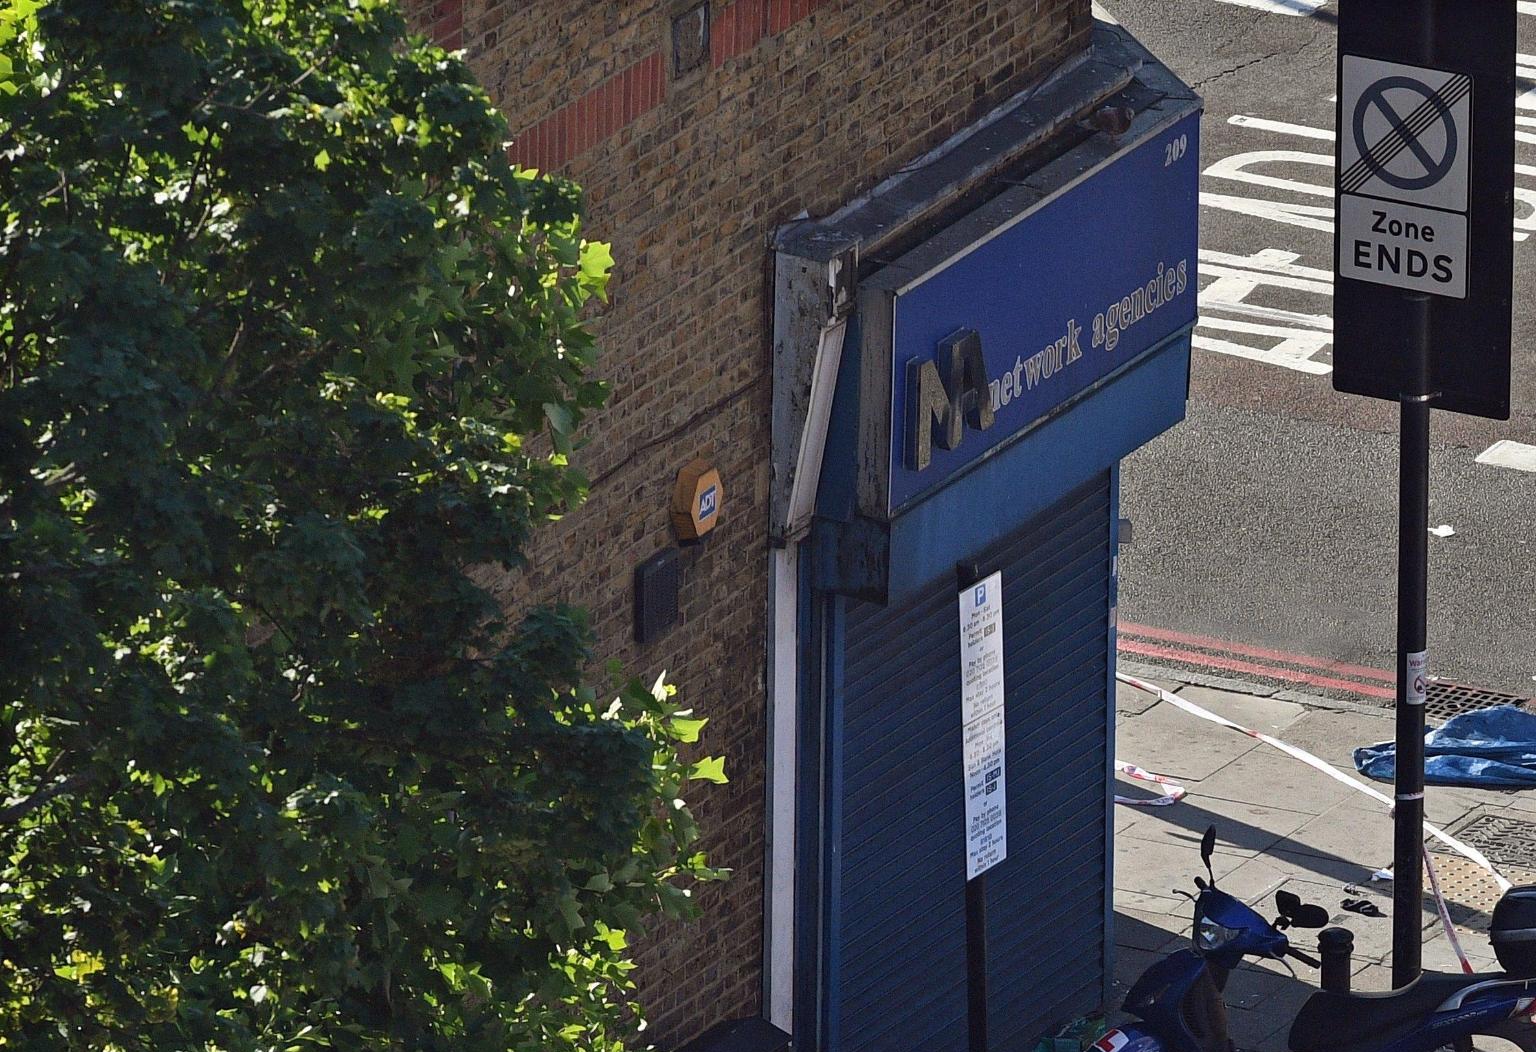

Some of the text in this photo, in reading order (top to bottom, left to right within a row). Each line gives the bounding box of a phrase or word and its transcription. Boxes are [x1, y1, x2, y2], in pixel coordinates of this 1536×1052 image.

[1164, 135, 1188, 167] 209
[1371, 210, 1436, 244] Zone
[1353, 240, 1454, 284] ENDS
[989, 257, 1188, 414] network agencies
[700, 491, 717, 513] ADT
[977, 586, 985, 604] P
[1096, 1029, 1119, 1052] L
